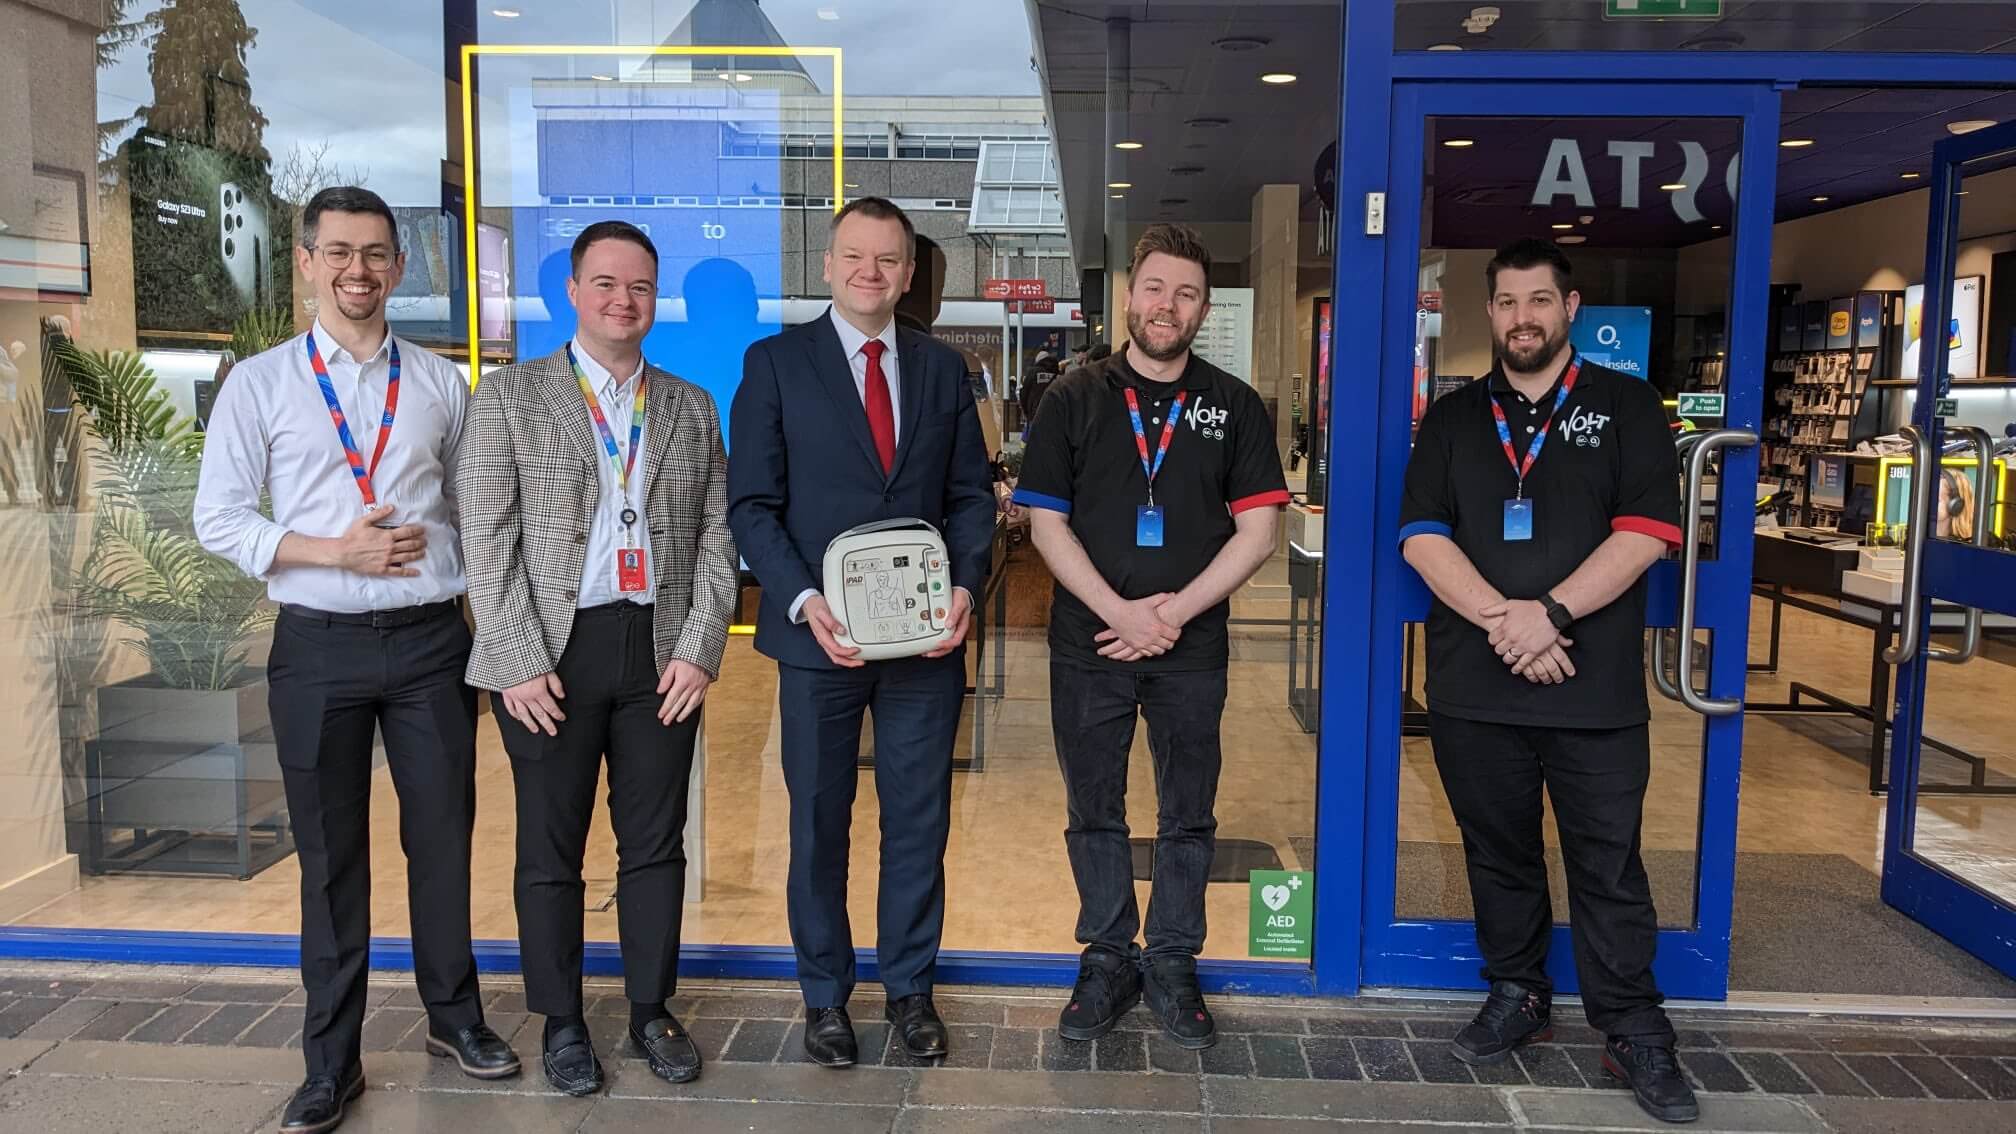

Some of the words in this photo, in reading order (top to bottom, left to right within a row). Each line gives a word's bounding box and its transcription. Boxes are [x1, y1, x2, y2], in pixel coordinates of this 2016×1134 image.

[157, 199, 180, 215] Galaxy
[180, 203, 191, 214] S23
[191, 206, 206, 218] Ultra
[157, 214, 167, 225] Buy
[167, 217, 178, 225] now
[701, 221, 726, 240] to
[1597, 325, 1621, 350] O2
[1605, 359, 1640, 372] inside,
[1889, 466, 1909, 478] JBL
[1266, 915, 1296, 928] AED
